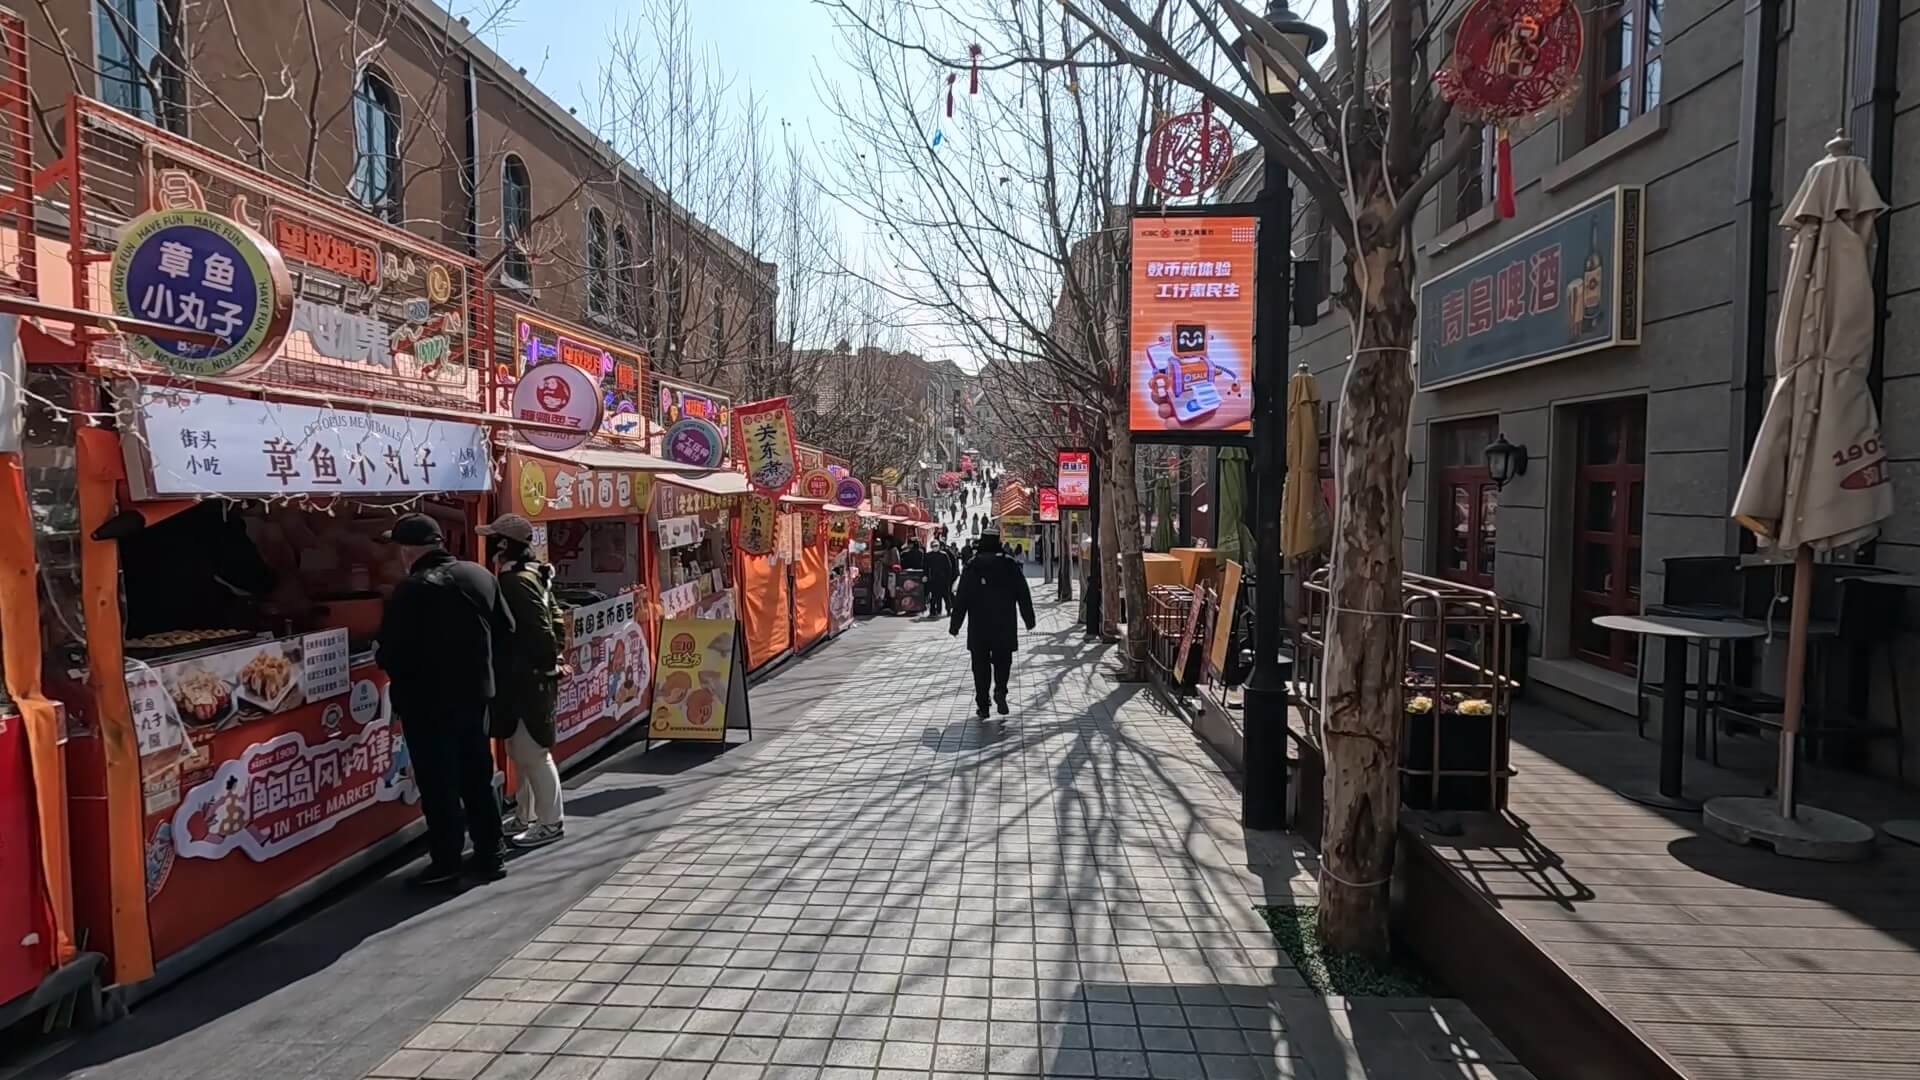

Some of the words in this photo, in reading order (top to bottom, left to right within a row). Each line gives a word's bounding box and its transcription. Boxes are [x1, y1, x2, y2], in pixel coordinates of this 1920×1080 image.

[136, 219, 161, 241] HAVE
[162, 214, 185, 225] FUN
[193, 216, 222, 233] HAVE
[222, 227, 243, 246] FUN
[120, 241, 136, 262] FUN
[157, 241, 235, 293] 章鱼
[116, 262, 126, 293] HAVE
[258, 280, 269, 309] HAVE
[1441, 244, 1562, 346] 青岛啤酒
[141, 283, 243, 345] 小丸子
[253, 312, 268, 333] FUN
[211, 356, 233, 370] FUN
[181, 428, 217, 449] 街头
[755, 424, 782, 477] 关东煮
[186, 455, 222, 475] 小吃
[264, 437, 437, 486] 章鱼小丸子
[549, 468, 632, 510] 金币面包
[574, 602, 634, 639] 韩国金币面包
[253, 731, 391, 820] 鲍岛风物集
[272, 818, 290, 839] IN
[296, 804, 321, 827] THE
[326, 780, 376, 815] MARKET
